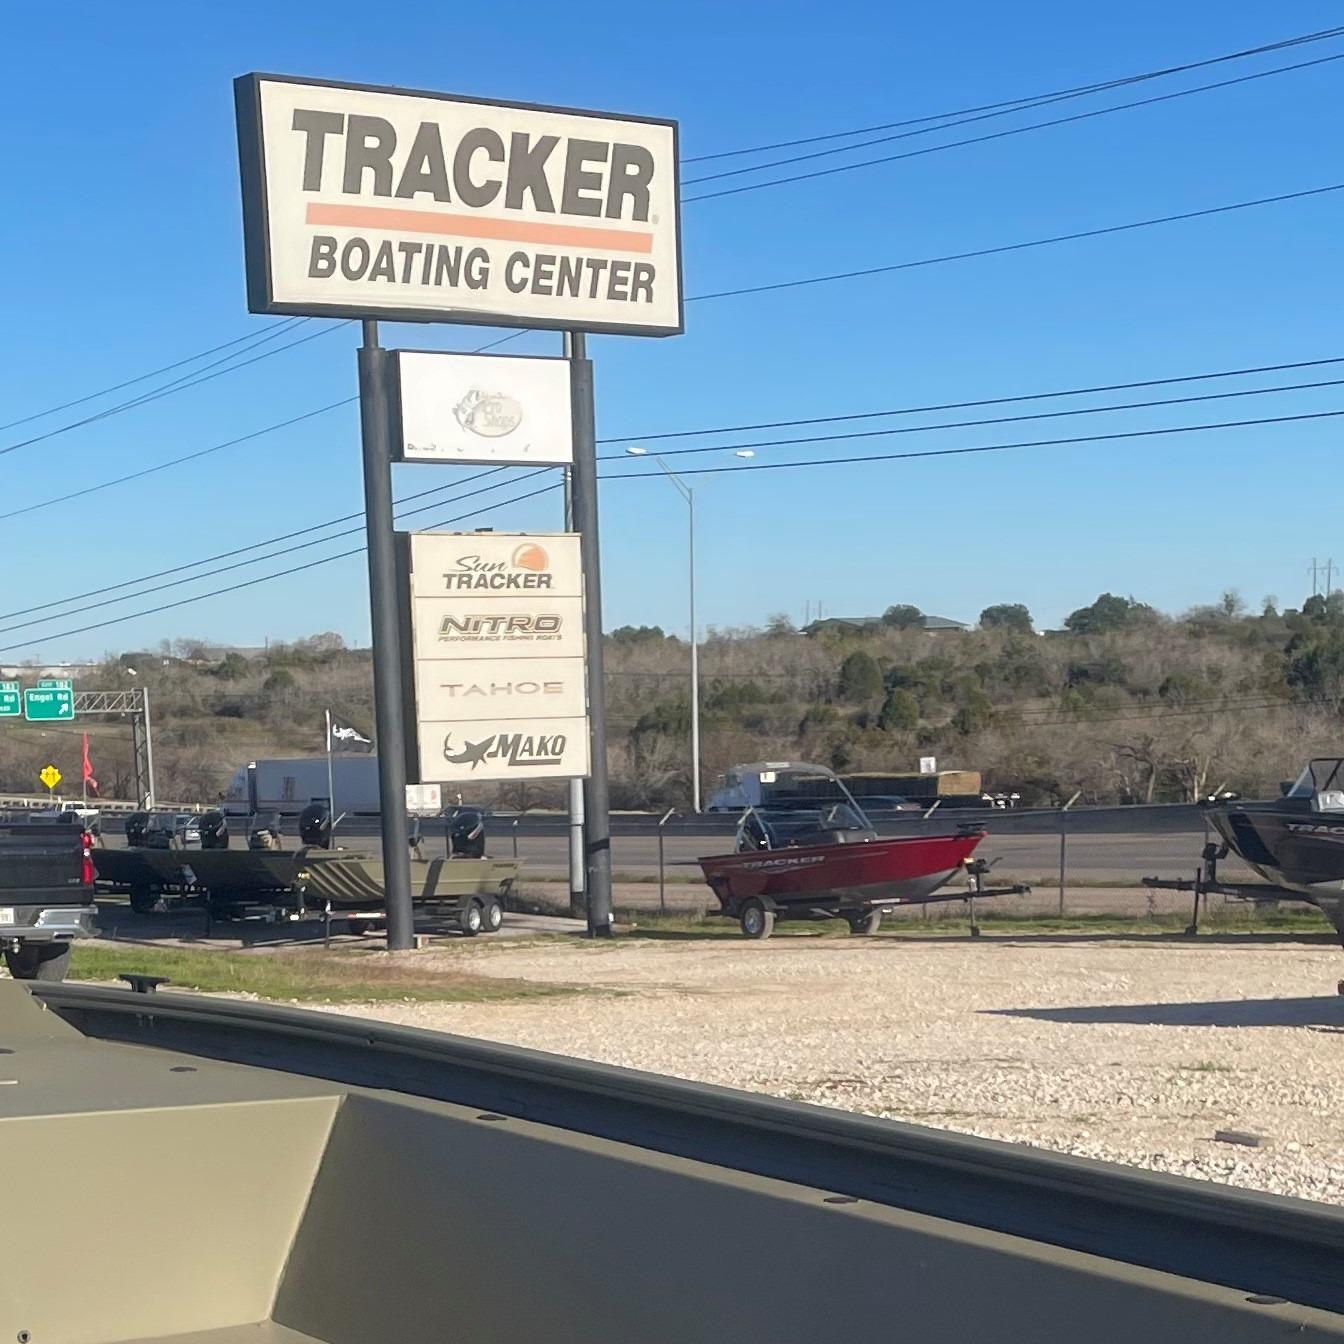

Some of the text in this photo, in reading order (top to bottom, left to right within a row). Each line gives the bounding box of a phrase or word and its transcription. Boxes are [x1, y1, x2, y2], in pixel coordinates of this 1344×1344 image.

[291, 108, 656, 222] TRACKER
[308, 235, 656, 303] BOATING CENTER
[452, 556, 506, 572] Sun
[443, 573, 553, 589] TRACKER
[438, 614, 564, 635] NITRO
[4, 694, 16, 702] Rd
[440, 681, 565, 698] TAHOE
[29, 693, 69, 704] Engel Rd
[486, 733, 567, 767] MAKO
